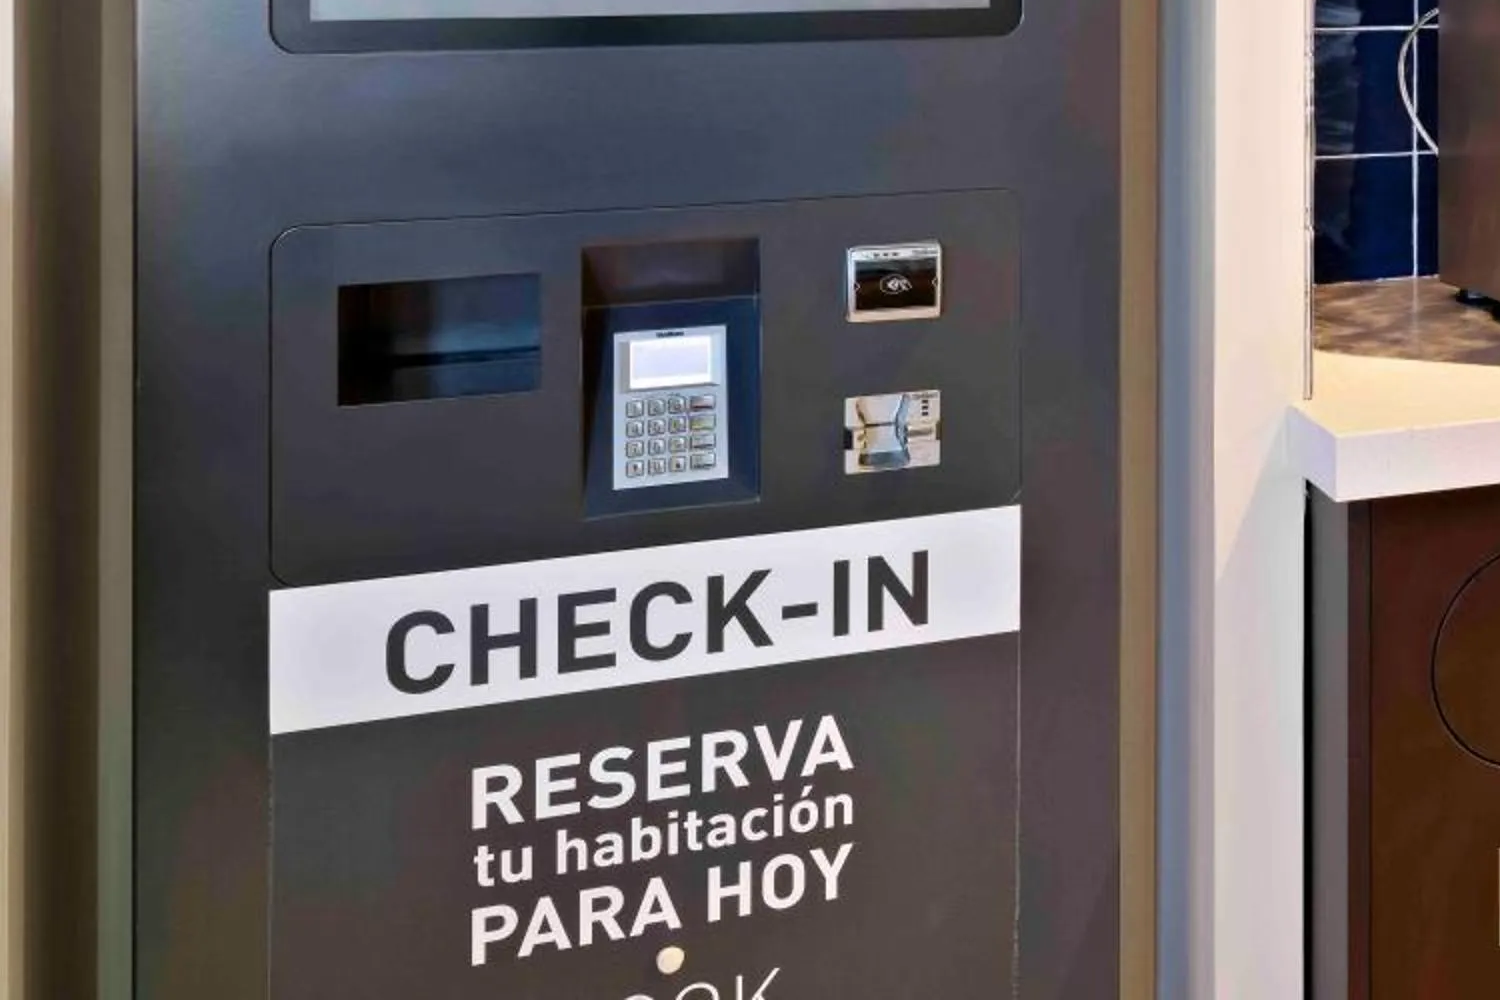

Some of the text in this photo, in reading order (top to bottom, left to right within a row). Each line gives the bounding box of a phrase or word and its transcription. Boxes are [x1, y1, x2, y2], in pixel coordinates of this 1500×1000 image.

[385, 550, 929, 695] CHECK-IN
[471, 714, 854, 830] RESERVA
[473, 784, 853, 887] tu habitación
[471, 842, 854, 967] PARA HOY
